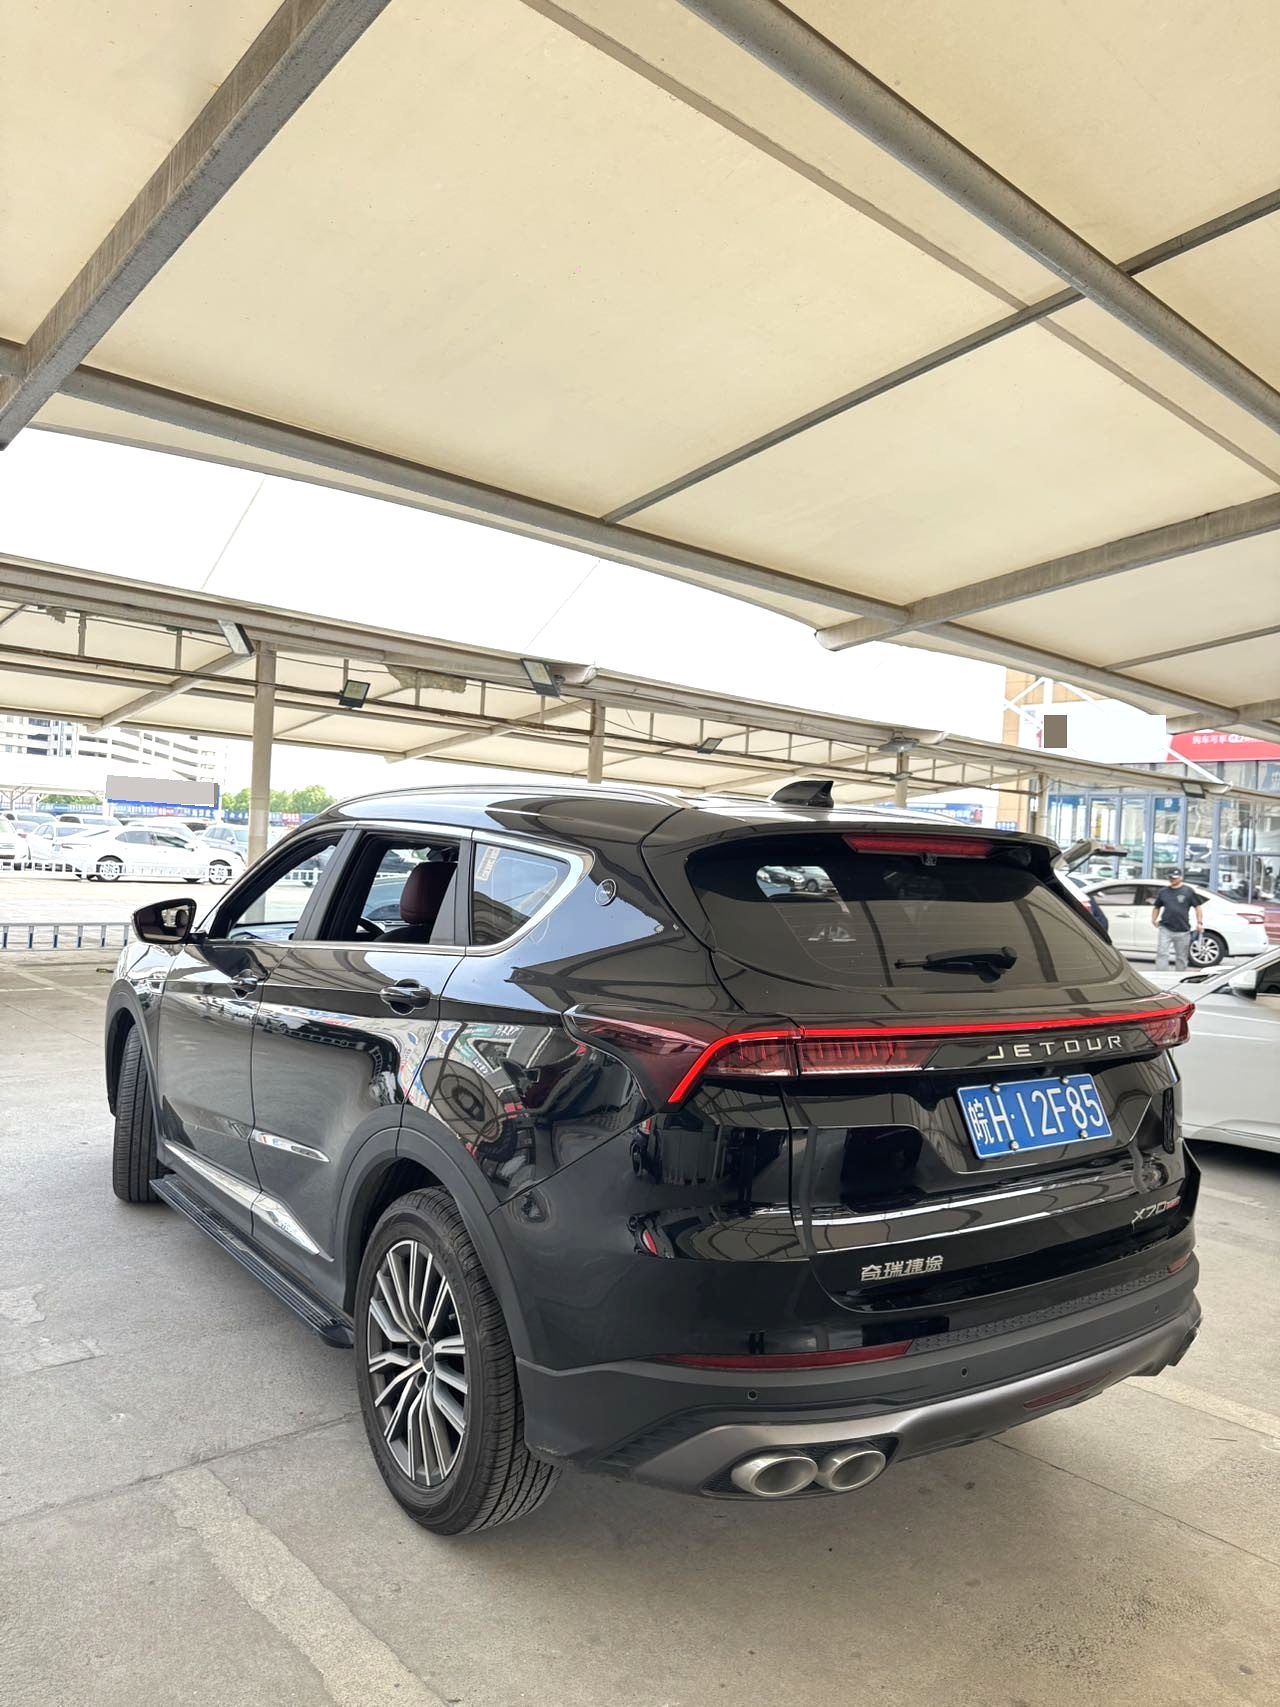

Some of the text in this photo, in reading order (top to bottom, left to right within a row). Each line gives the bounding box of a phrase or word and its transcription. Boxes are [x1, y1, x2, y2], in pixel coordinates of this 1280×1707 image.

[987, 1035, 1122, 1060] JETOUR
[860, 1255, 944, 1282] 奇瑞捷途
